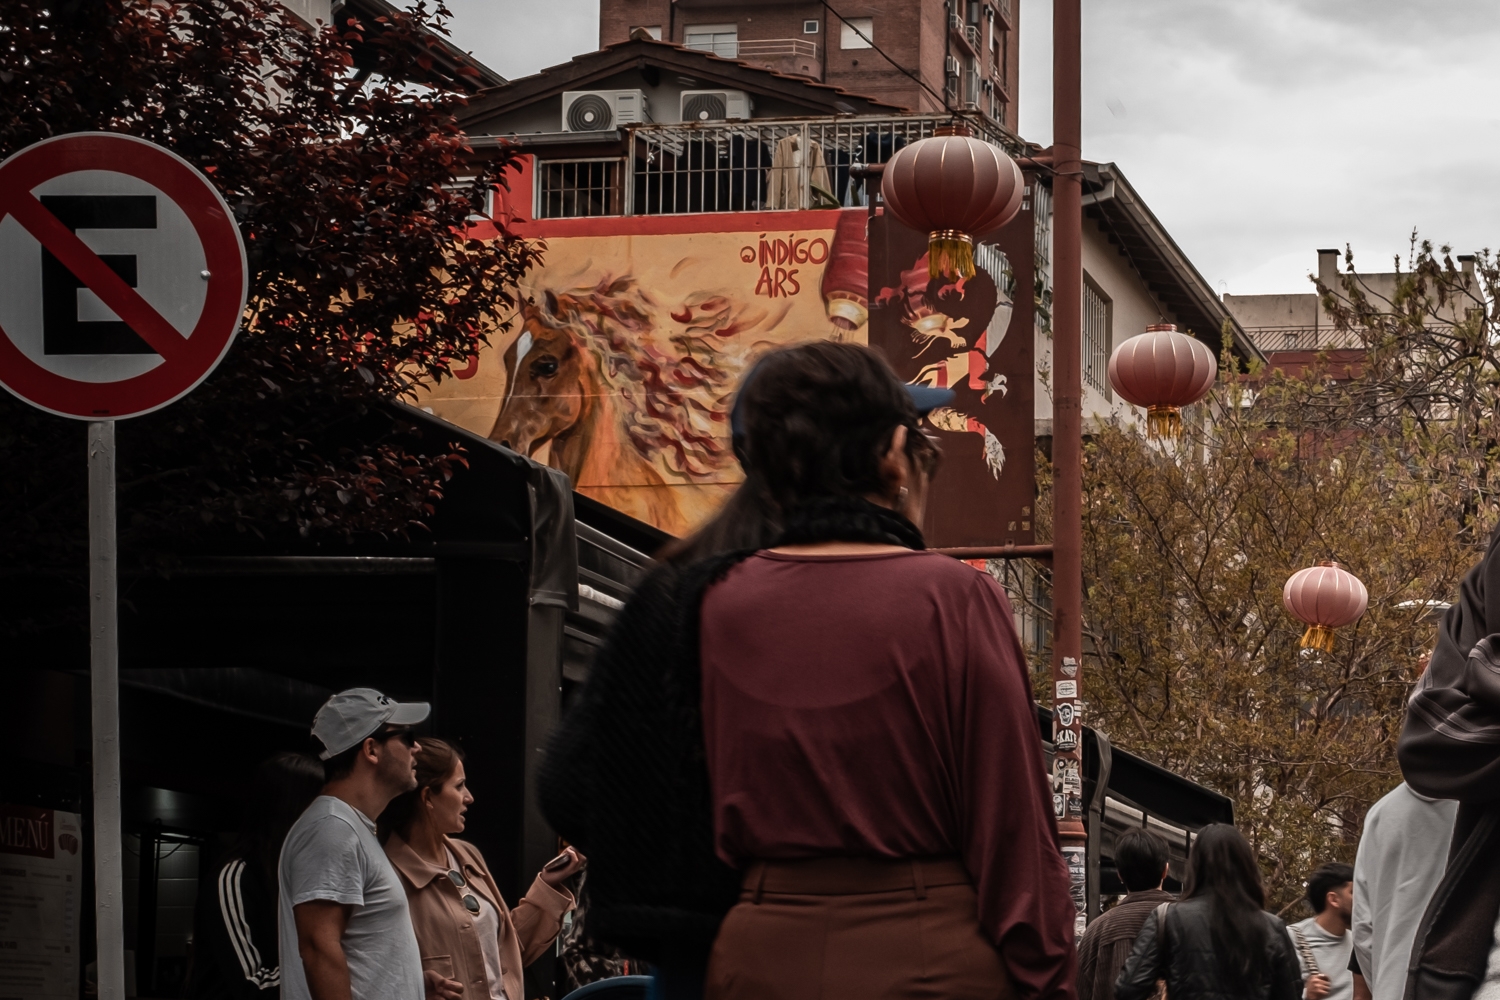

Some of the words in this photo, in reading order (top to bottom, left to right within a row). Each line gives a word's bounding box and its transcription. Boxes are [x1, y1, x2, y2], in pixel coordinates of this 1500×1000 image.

[41, 195, 157, 355] E
[755, 266, 800, 298] ARS
[1056, 729, 1077, 746] SKATE
